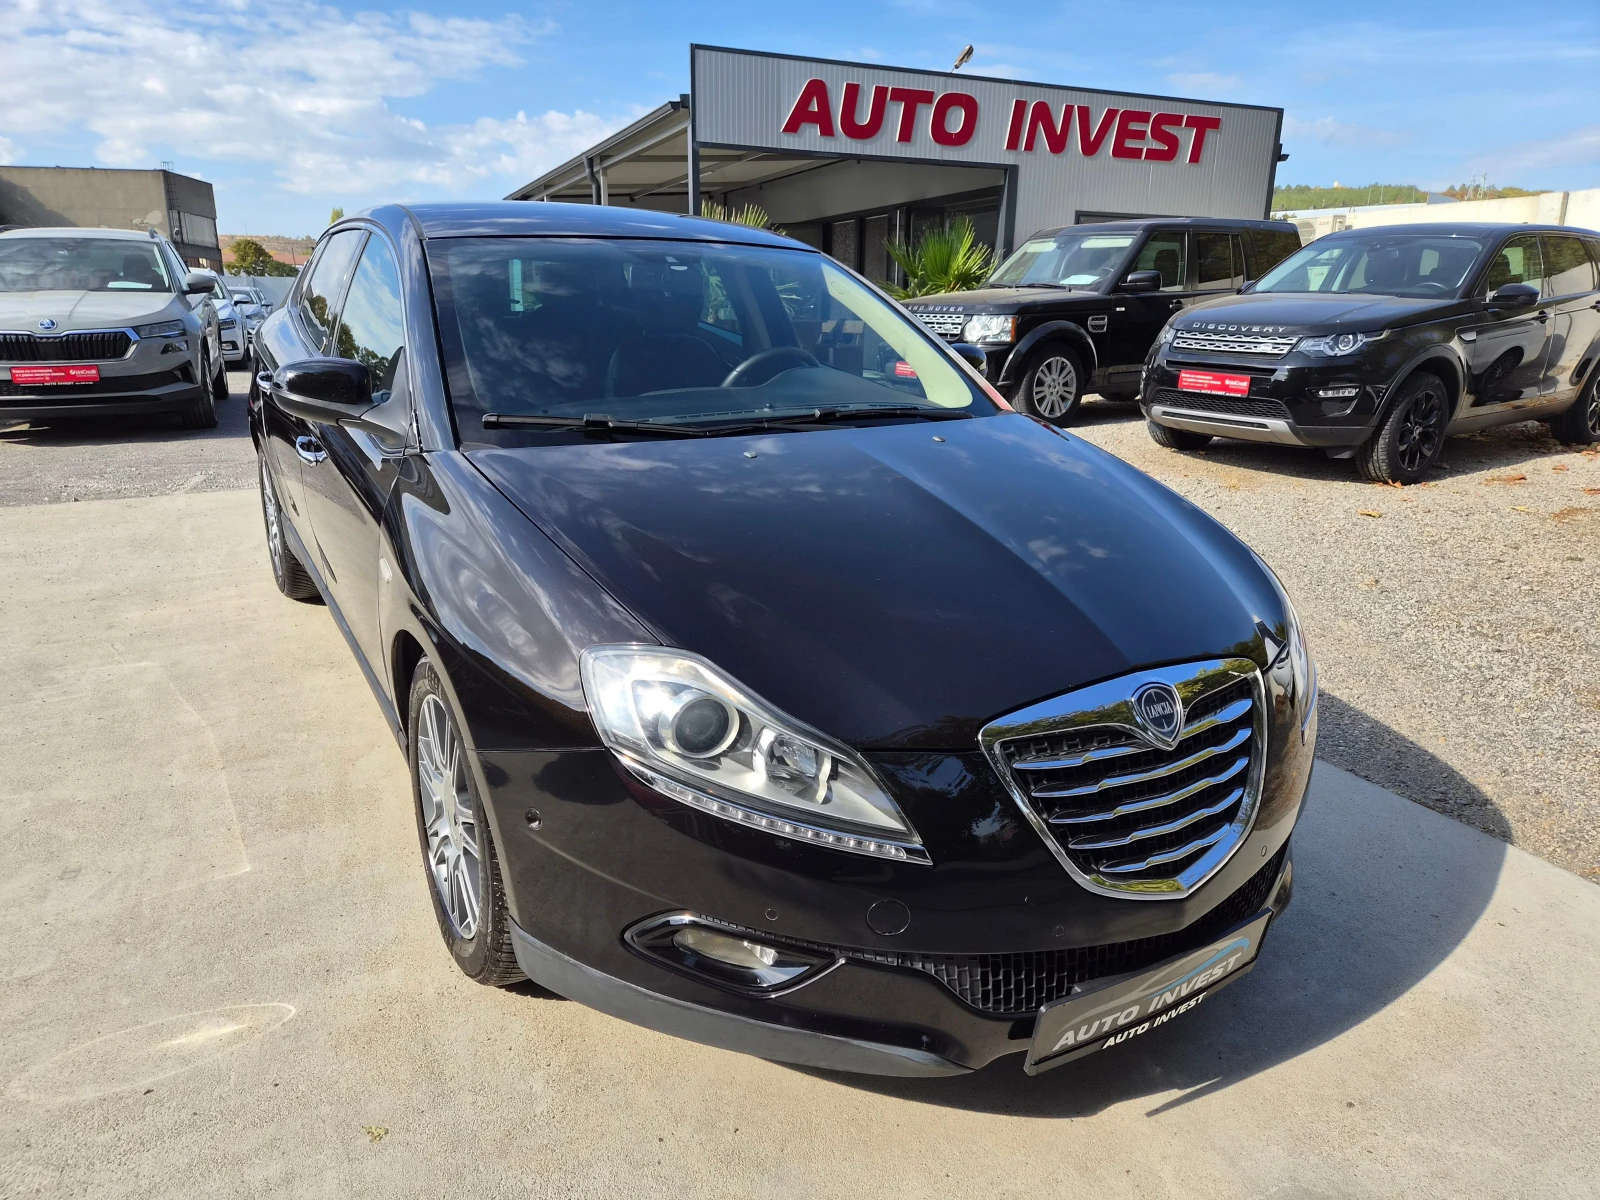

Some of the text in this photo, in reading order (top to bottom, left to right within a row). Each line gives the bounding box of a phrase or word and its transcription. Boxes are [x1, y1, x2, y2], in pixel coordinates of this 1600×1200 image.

[780, 78, 1222, 165] AUTO INVEST
[1192, 322, 1287, 333] DISCOVERY
[1146, 701, 1174, 719] LANCIA
[1051, 952, 1242, 1052] AUTO INVEST
[1102, 992, 1207, 1050] AUTO INVEST
